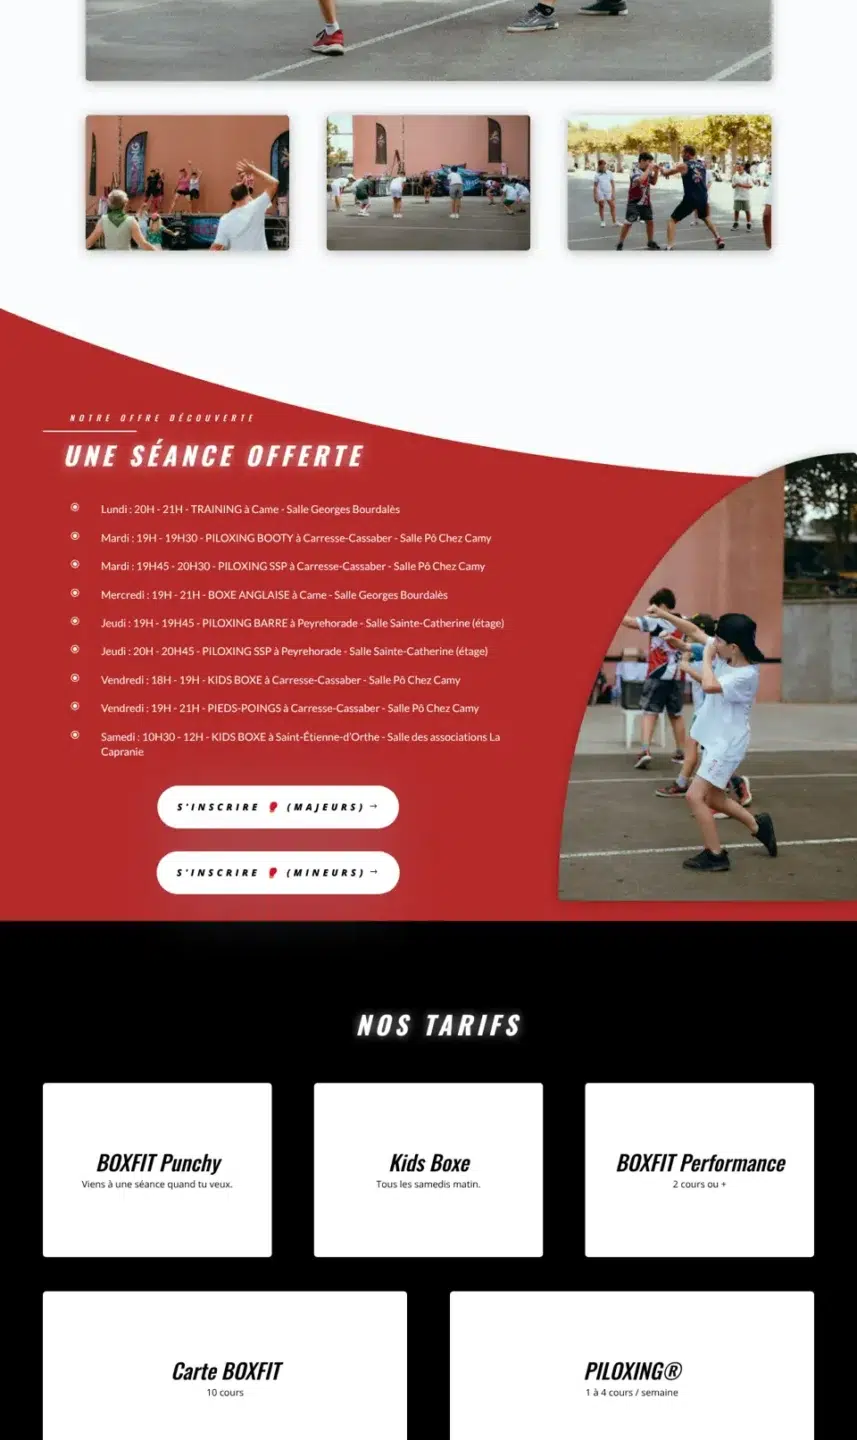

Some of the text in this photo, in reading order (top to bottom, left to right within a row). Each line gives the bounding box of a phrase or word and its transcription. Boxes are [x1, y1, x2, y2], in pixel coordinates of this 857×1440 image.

[69, 412, 253, 423] NOTRE OFFRE DÉCOUVERTE
[65, 438, 363, 467] UNE SÉANCE OFFERTE
[101, 504, 128, 514] Lundi
[134, 504, 155, 514] 20H
[162, 504, 183, 514] 21H
[190, 504, 243, 514] TRAINING
[243, 504, 250, 514] à
[251, 504, 280, 514] Came
[286, 504, 310, 514] Salle
[310, 504, 351, 516] Georges
[352, 504, 401, 514] Bourdalès
[100, 747, 144, 758] Capranie
[177, 803, 363, 813] S'INSCRIRE (MAJEURS)
[176, 868, 364, 878] S'INSCRIRE (MINEURS)
[357, 1014, 520, 1037] NOS TARIFS
[96, 1153, 222, 1176] BOXFIT Punchy
[389, 1153, 471, 1173] Kids Boxe
[616, 1153, 786, 1172] BOXFIT Performance
[81, 1179, 233, 1190] Viens à une séance quand tu veux.
[376, 1179, 480, 1189] Tous les samedis matin.
[672, 1180, 679, 1189] 2
[680, 1181, 706, 1189] cours
[707, 1181, 719, 1189] ou
[172, 1361, 284, 1381] Carte BOXFIT
[584, 1361, 683, 1381] PILOXING®
[207, 1388, 218, 1397] 10
[586, 1388, 590, 1396] 1
[593, 1388, 599, 1397] à
[600, 1388, 607, 1397] 4
[635, 1388, 639, 1397] /
[641, 1389, 679, 1397] semaine
